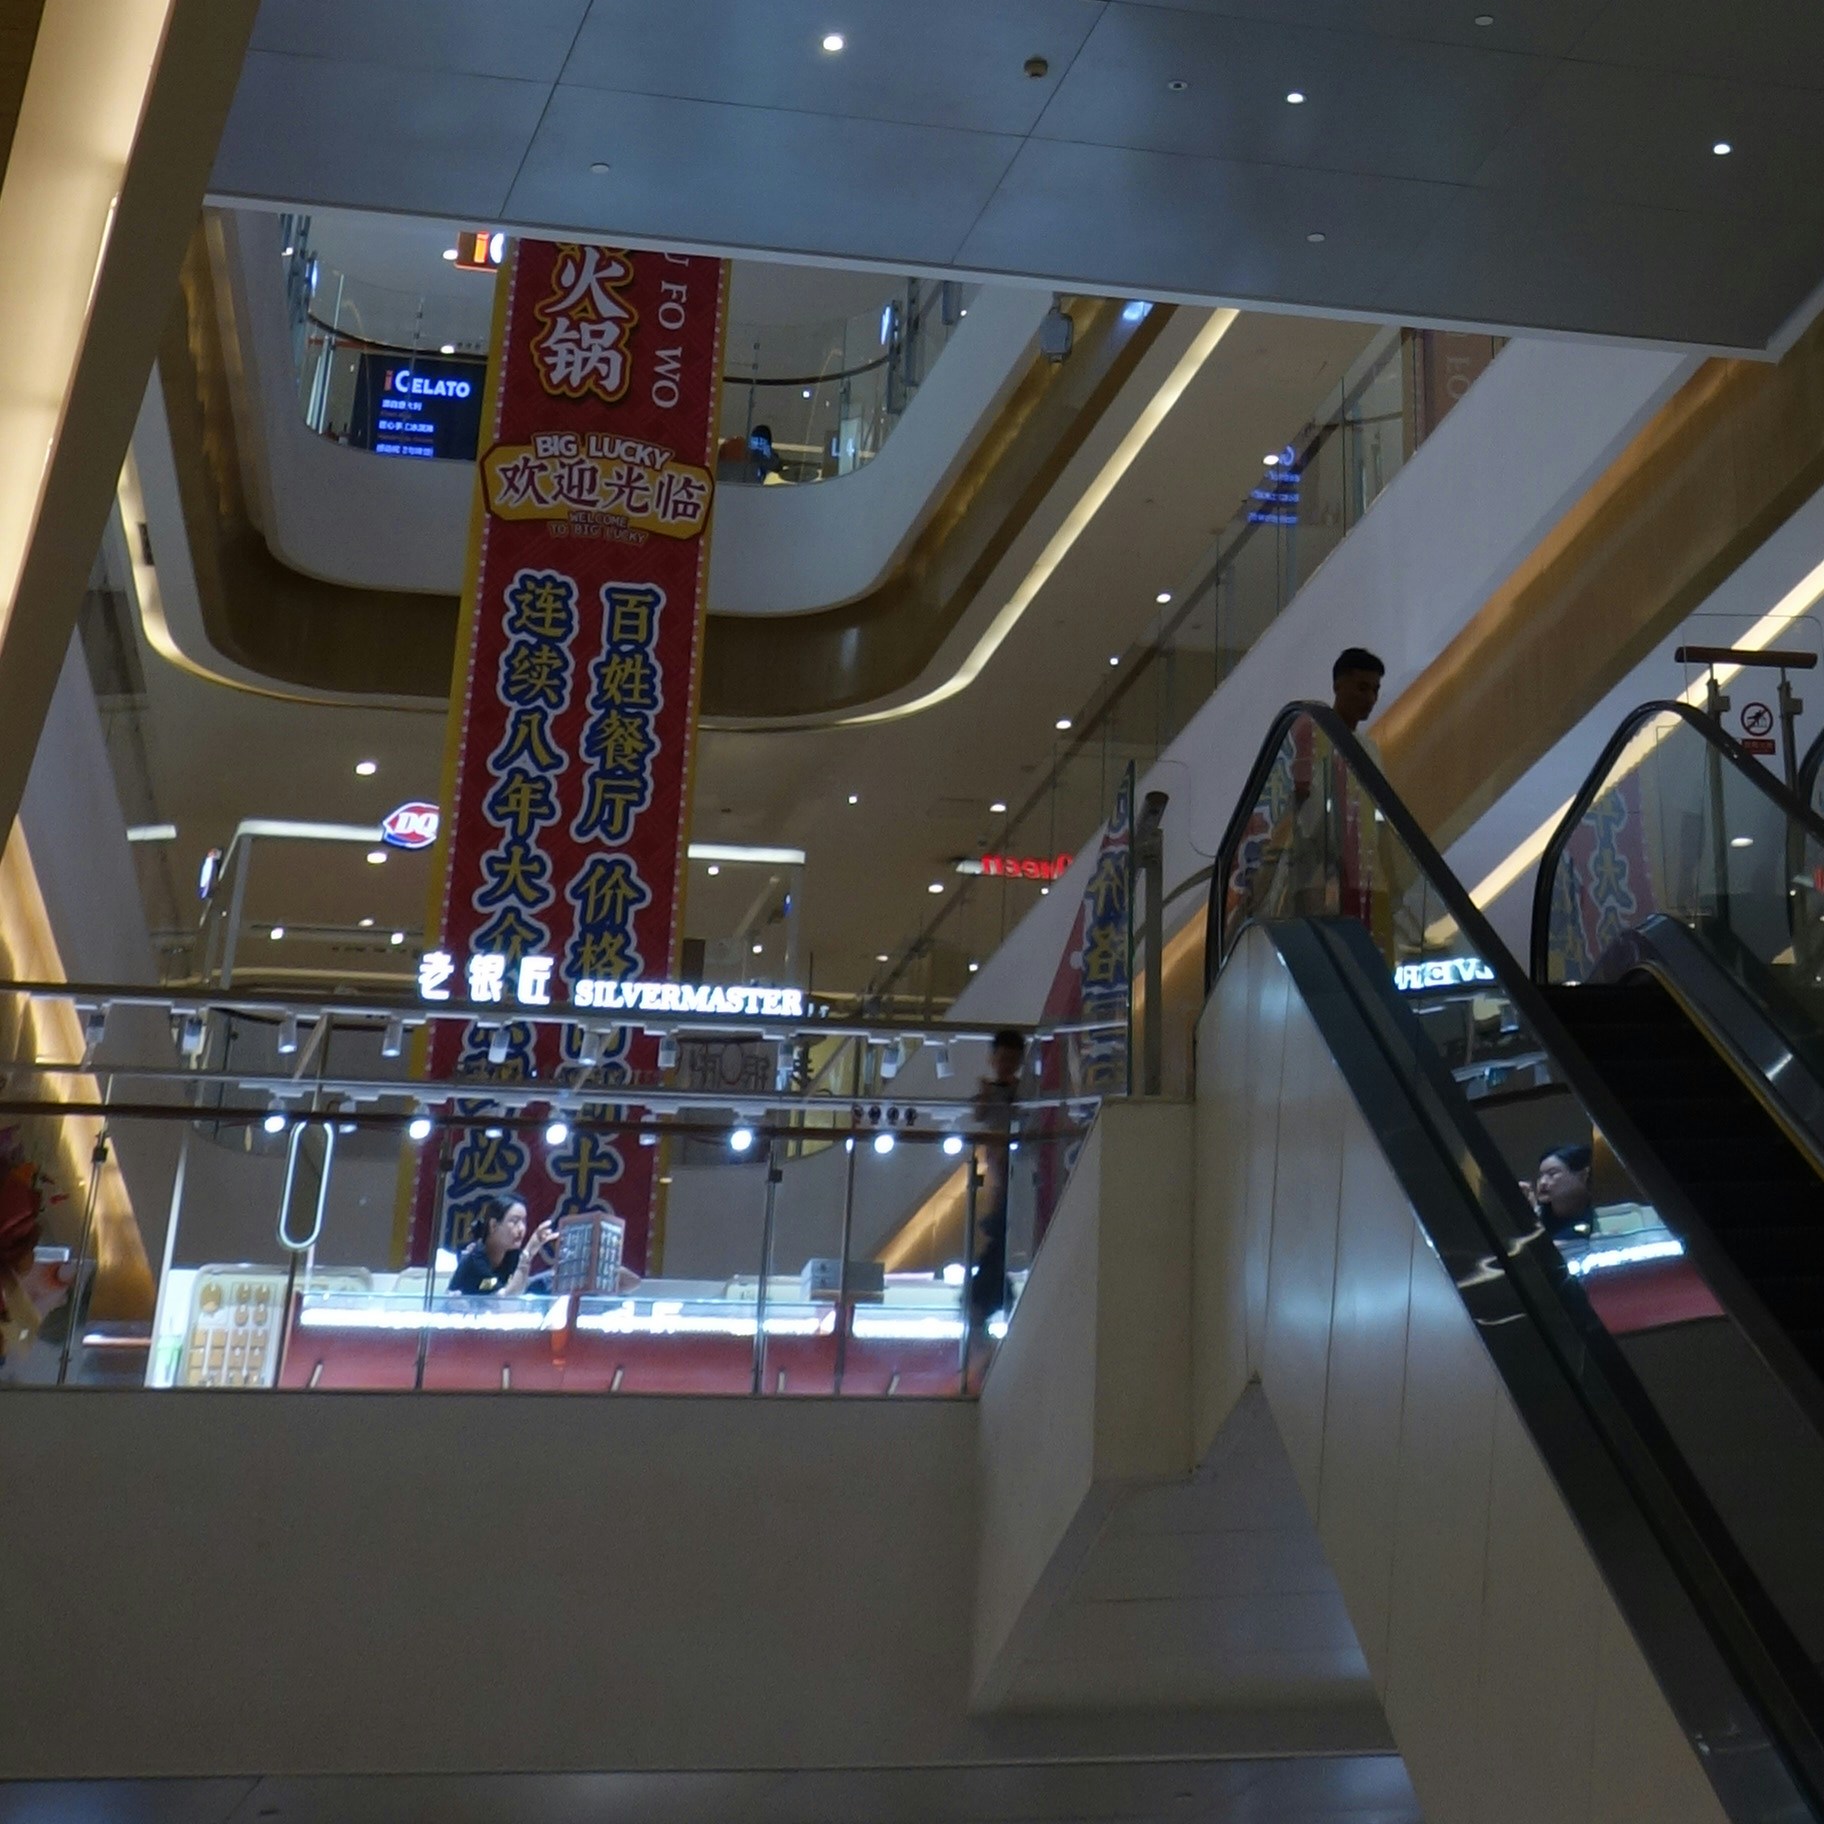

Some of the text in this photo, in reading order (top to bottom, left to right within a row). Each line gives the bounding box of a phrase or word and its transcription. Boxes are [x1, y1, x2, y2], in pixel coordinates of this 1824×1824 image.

[538, 242, 632, 395] 火锅
[657, 279, 688, 332] FO
[651, 345, 685, 410] WO
[535, 434, 673, 472] BIG LUCKY
[497, 455, 708, 522] 欢迎光临
[549, 522, 648, 544] TO BIG LUCKY
[568, 511, 629, 528] WELCOME
[581, 590, 658, 842] 百姓餐厅
[395, 811, 440, 838] DQ
[416, 950, 806, 1017] 老银匠 SILVERMASTER
